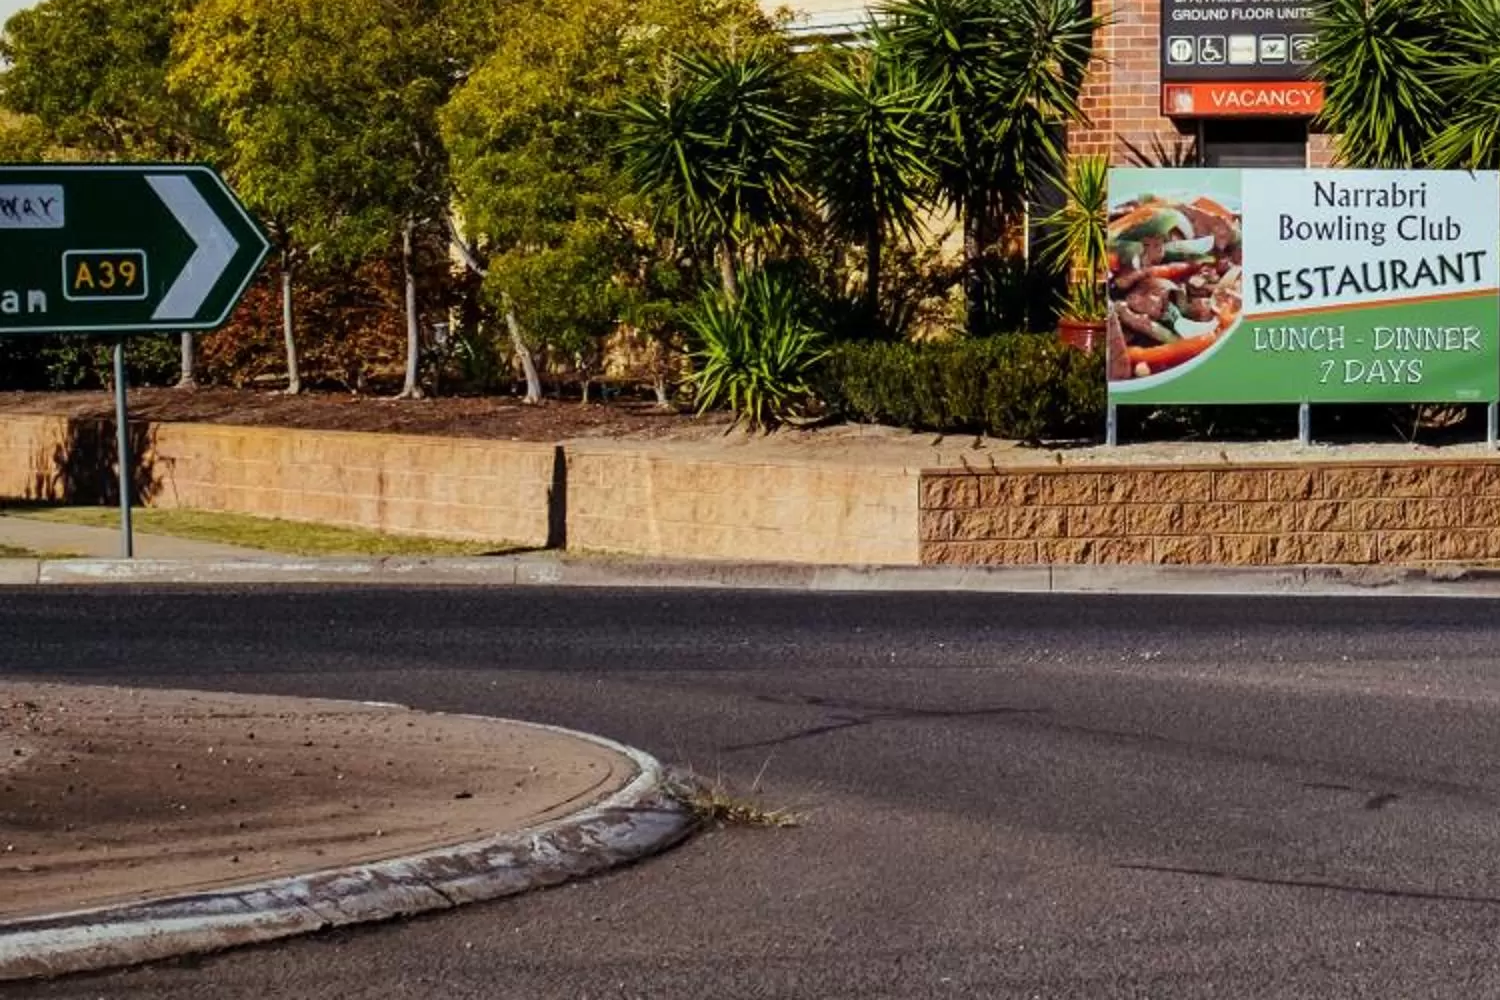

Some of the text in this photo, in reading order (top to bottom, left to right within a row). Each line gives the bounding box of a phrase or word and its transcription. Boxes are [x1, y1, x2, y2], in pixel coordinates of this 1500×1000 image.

[1171, 8, 1228, 21] GROUND
[1231, 8, 1275, 20] FLOOR
[1210, 89, 1316, 107] VACANCY
[1313, 181, 1427, 207] Narrabri
[1279, 215, 1462, 245] Bowling Club
[74, 261, 137, 290] A39
[1253, 250, 1488, 305] RESTAURANT
[1253, 326, 1345, 352] LUNCH
[1372, 326, 1481, 352] DINNER
[1318, 358, 1424, 384] 7 DAYS
